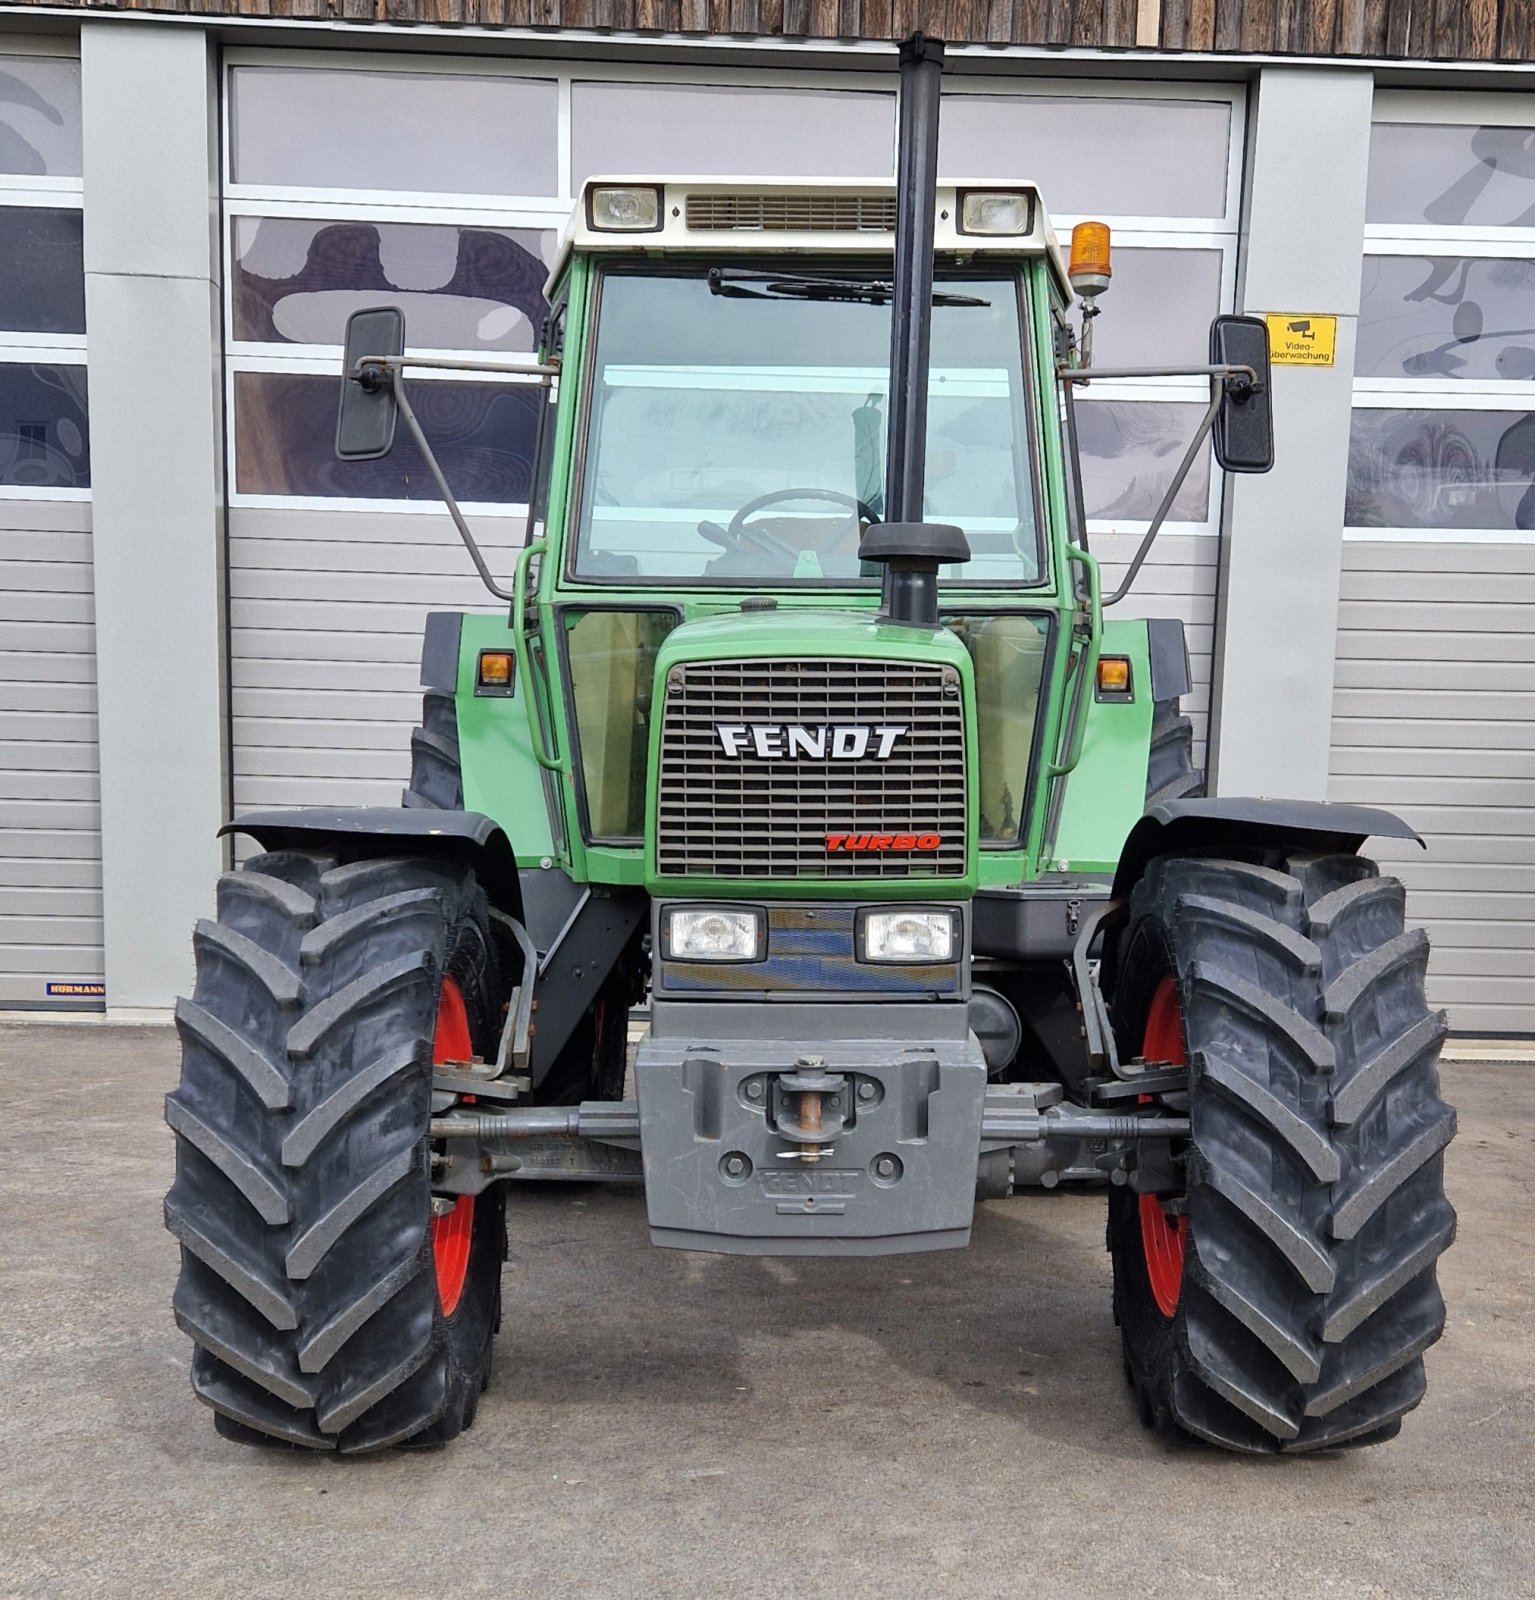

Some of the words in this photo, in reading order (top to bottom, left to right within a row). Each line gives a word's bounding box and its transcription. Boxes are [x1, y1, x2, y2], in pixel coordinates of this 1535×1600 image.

[1285, 341, 1314, 351] Video-
[715, 724, 909, 760] FENDT
[824, 833, 942, 852] TURBO
[763, 1172, 860, 1192] FENDT
